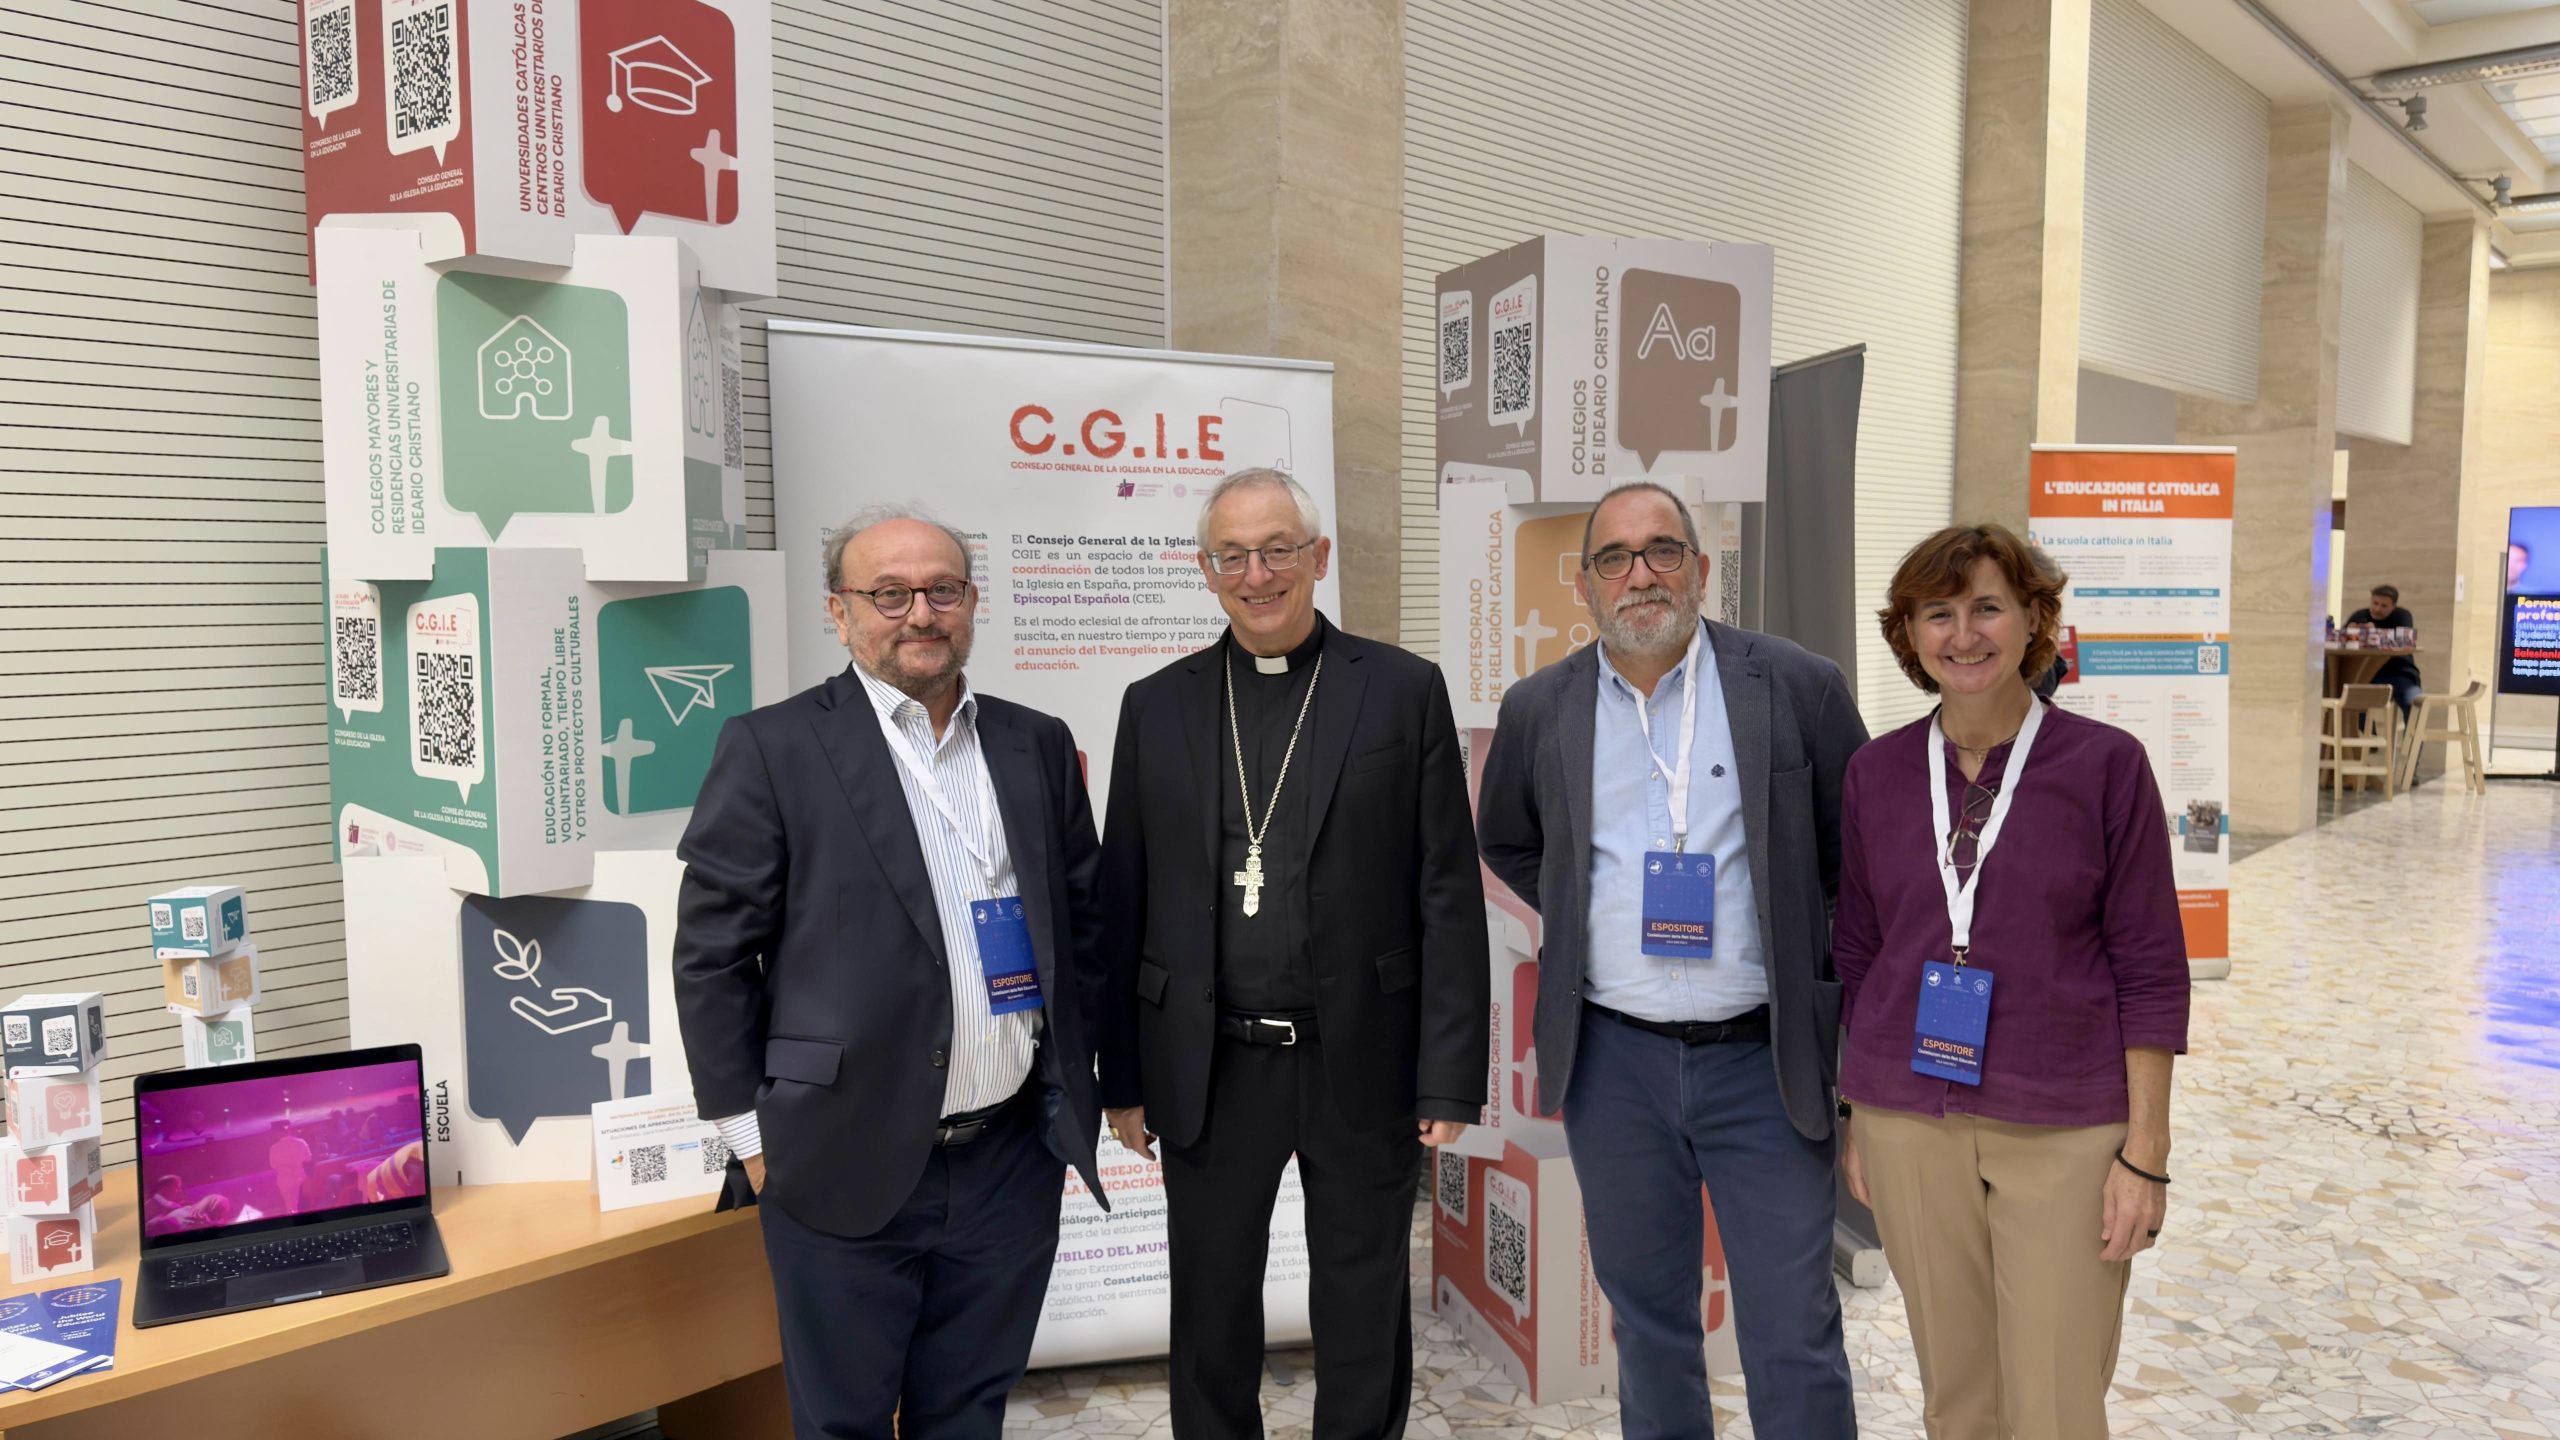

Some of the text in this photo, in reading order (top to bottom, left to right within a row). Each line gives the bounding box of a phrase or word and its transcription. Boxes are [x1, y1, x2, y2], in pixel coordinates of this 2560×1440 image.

[512, 3, 531, 212] UNIVERSIDADES CATÓLICAS
[532, 18, 548, 215] CENTROS UNIVERSITARIOS
[310, 128, 362, 149] CONGRESO IGLESIA
[551, 75, 565, 218] IDEARIO CRISTIANO
[418, 168, 463, 186] CONSEJO GENERAL
[403, 189, 420, 199] IGLESIA
[1495, 294, 1522, 314] C.G.I.E
[1592, 266, 1610, 476] DE IDEARIO CRISTIANO
[382, 280, 404, 534] RESIDENCIAS UNIVERSITARIAS DE
[1010, 404, 1224, 461] C.G.I.E
[1572, 380, 1587, 476] COLEGIOS
[366, 360, 384, 534] COLEGIOS MAYORES Y
[407, 382, 424, 534] IDEARIO CRISTIANO
[1011, 461, 1052, 470] CONSEJO
[1054, 464, 1092, 472] GENERAL
[1120, 466, 1150, 474] IGLESIA
[1178, 466, 1225, 476] EDUCACIÓN
[2044, 481, 2220, 496] L'EDUCAZIONE CATTOLICA
[2102, 500, 2164, 512] IN ITALIA
[1012, 534, 1022, 544] El
[1027, 536, 1074, 548] Consejo
[1078, 536, 1126, 546] General
[1130, 536, 1144, 546] de
[1148, 537, 1160, 546] la
[2042, 536, 2172, 546] La scuola cattolica in Italia
[1012, 550, 1199, 562] CGIE es un espacio de diálog
[1012, 565, 1164, 575] coordinación de todos los
[1012, 580, 1196, 592] la Iglesia en España, promovido
[1014, 594, 1166, 606] Episcopal Española (CEE).
[1486, 510, 1502, 703] DE RELIGIÓN CATÓLICA
[2518, 596, 2560, 608] Forma
[416, 612, 457, 632] C.G.I.E
[1014, 616, 1208, 626] Es el modo eclesial de afrontar los
[2517, 609, 2560, 622] profes
[1014, 631, 1058, 642] suscita,
[1078, 632, 1122, 640] nuestro
[1125, 631, 1166, 642] tiempo
[1169, 632, 1176, 642] y
[1178, 632, 1205, 642] para
[1470, 578, 1482, 702] PROFESORADO
[1014, 644, 1188, 657] el anuncio del Evangelio en la
[1015, 660, 1080, 670] educación.
[568, 596, 586, 842] Y OTROS PROYECTOS CULTURALES
[335, 730, 386, 742] CONGRESO IGLESIA
[554, 628, 572, 843] VOLUNTARIADO, TIEMPO LIBRE
[541, 667, 556, 844] EDUCACIÓN NO FORMAL,
[427, 813, 444, 822] IGLESIA
[442, 806, 488, 820] CONSEJO GENERAL
[1652, 922, 1704, 934] ESPOSITORE
[992, 974, 1033, 988] ESPOSITORE
[1923, 1038, 1974, 1057] ESPOSITORE
[1491, 1002, 1500, 1128] DE IDEARIO CRISTIANO
[436, 1080, 450, 1142] ESCUELA
[1119, 1193, 1162, 1206] aprueba
[1105, 1206, 1168, 1222] participaci
[1085, 1226, 1098, 1236] de
[1101, 1226, 1111, 1235] la
[1107, 1246, 1134, 1258] DEL
[1089, 1258, 1166, 1274] Extraordinario
[1062, 1282, 1072, 1291] la
[1075, 1281, 1101, 1292] gran
[1098, 1292, 1116, 1302] nos
[1120, 1286, 1167, 1299] sentimos
[1580, 1240, 1588, 1366] CENTROS DE FORMACIÓN
[1591, 1312, 1600, 1365] DE IDEARIO
